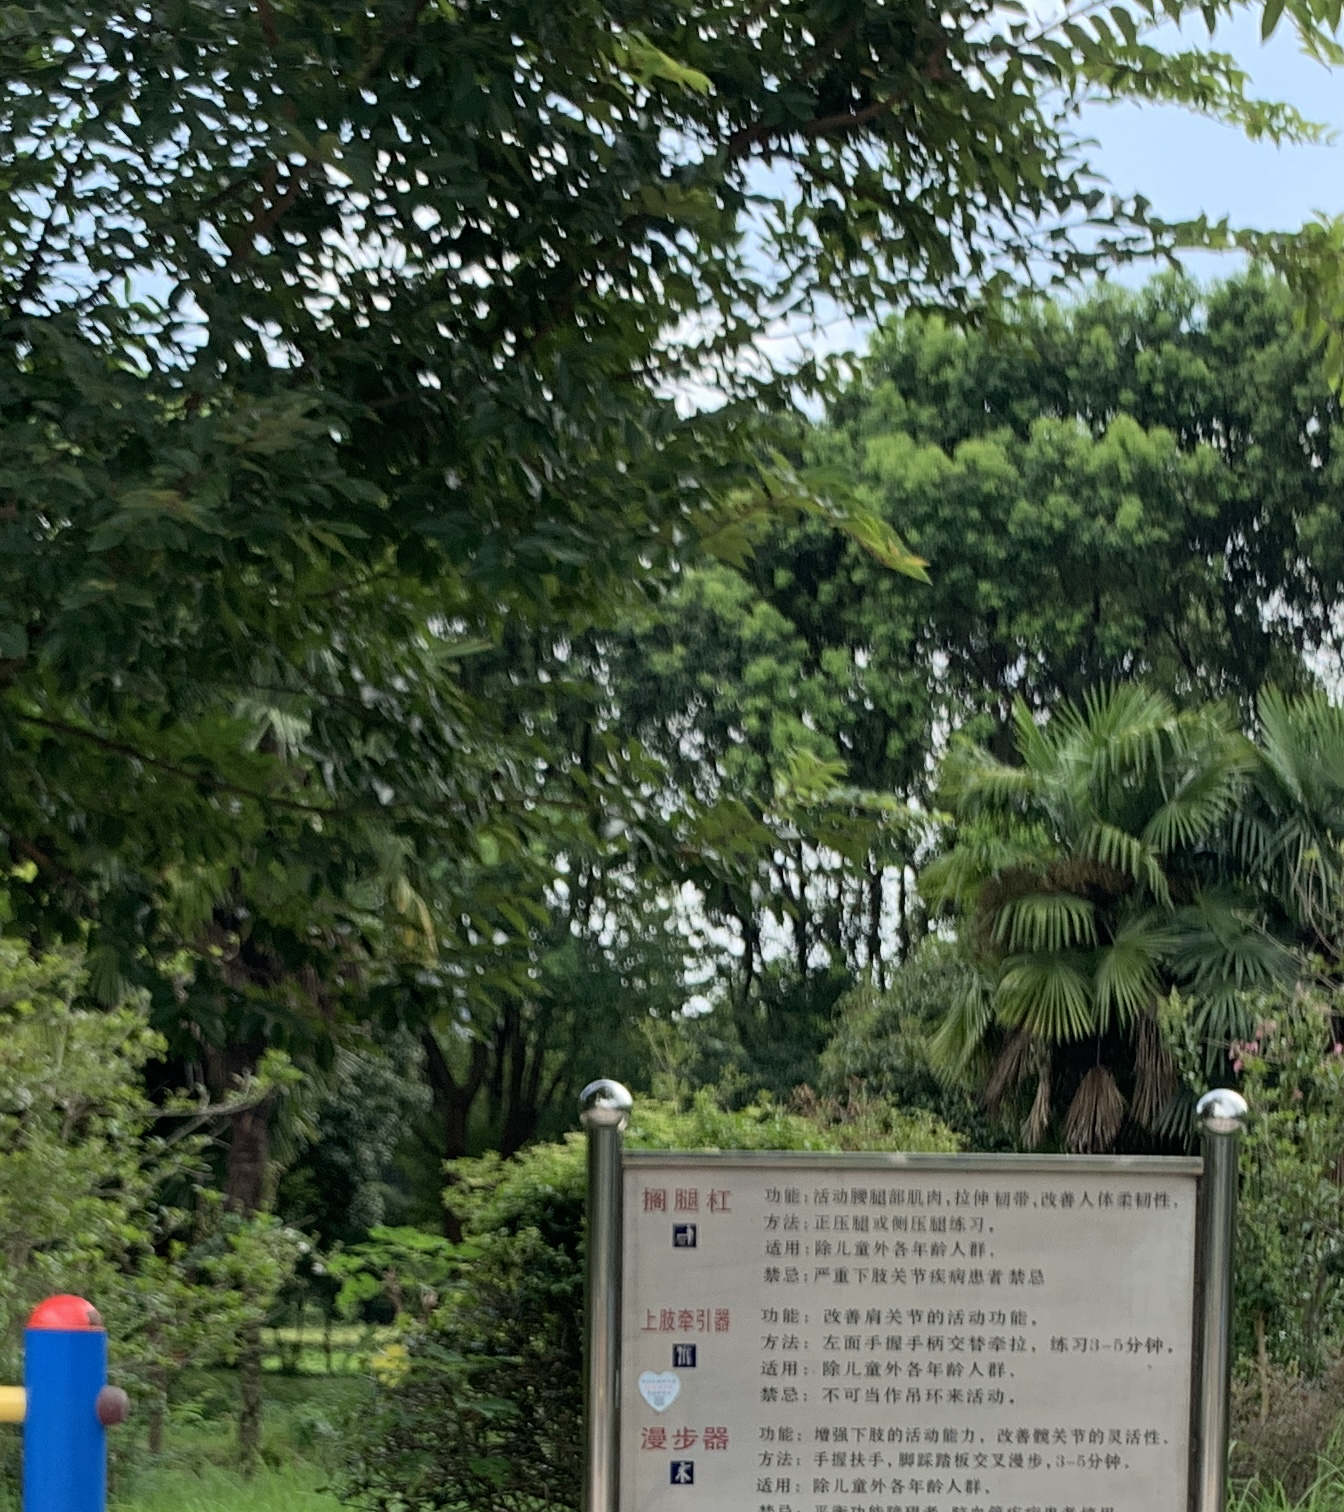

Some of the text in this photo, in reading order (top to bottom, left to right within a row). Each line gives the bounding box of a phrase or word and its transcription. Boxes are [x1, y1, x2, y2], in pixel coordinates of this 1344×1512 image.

[642, 1187, 733, 1213] 搁腿杠
[641, 1308, 730, 1333] 上肢牵引器
[641, 1426, 729, 1450] 漫步器
